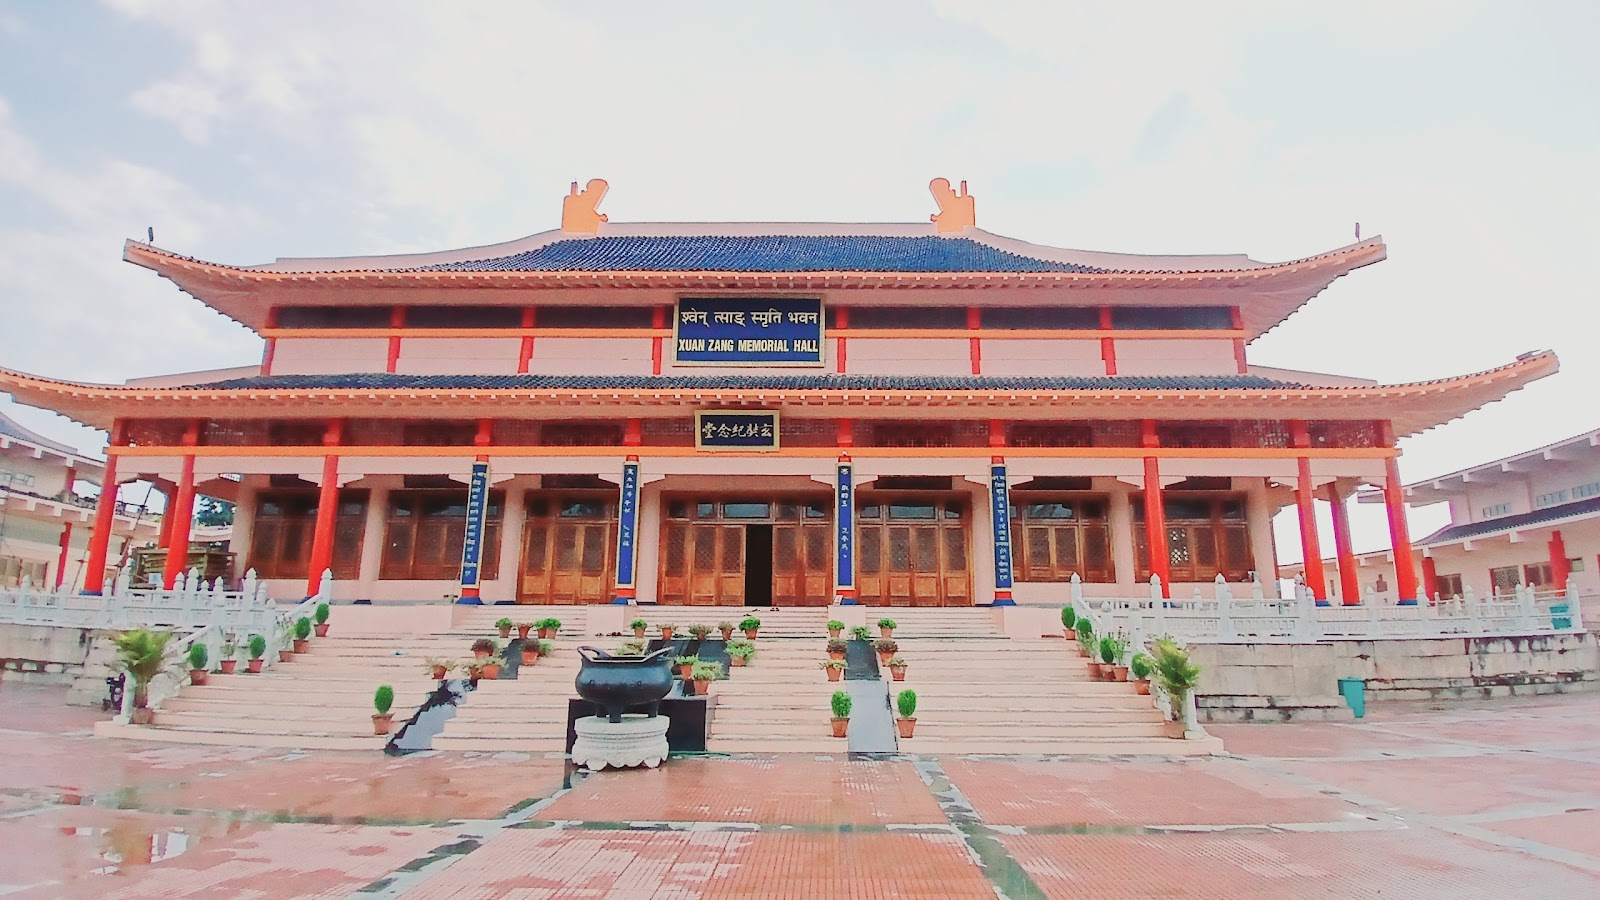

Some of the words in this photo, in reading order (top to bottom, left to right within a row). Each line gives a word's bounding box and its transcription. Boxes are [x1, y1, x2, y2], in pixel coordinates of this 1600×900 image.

[750, 308, 782, 327] स्मृति
[788, 312, 818, 324] भवन
[679, 339, 706, 352] XUAN
[708, 339, 734, 352] ZANG
[738, 339, 789, 352] MEMORIAL
[794, 340, 818, 352] HALL
